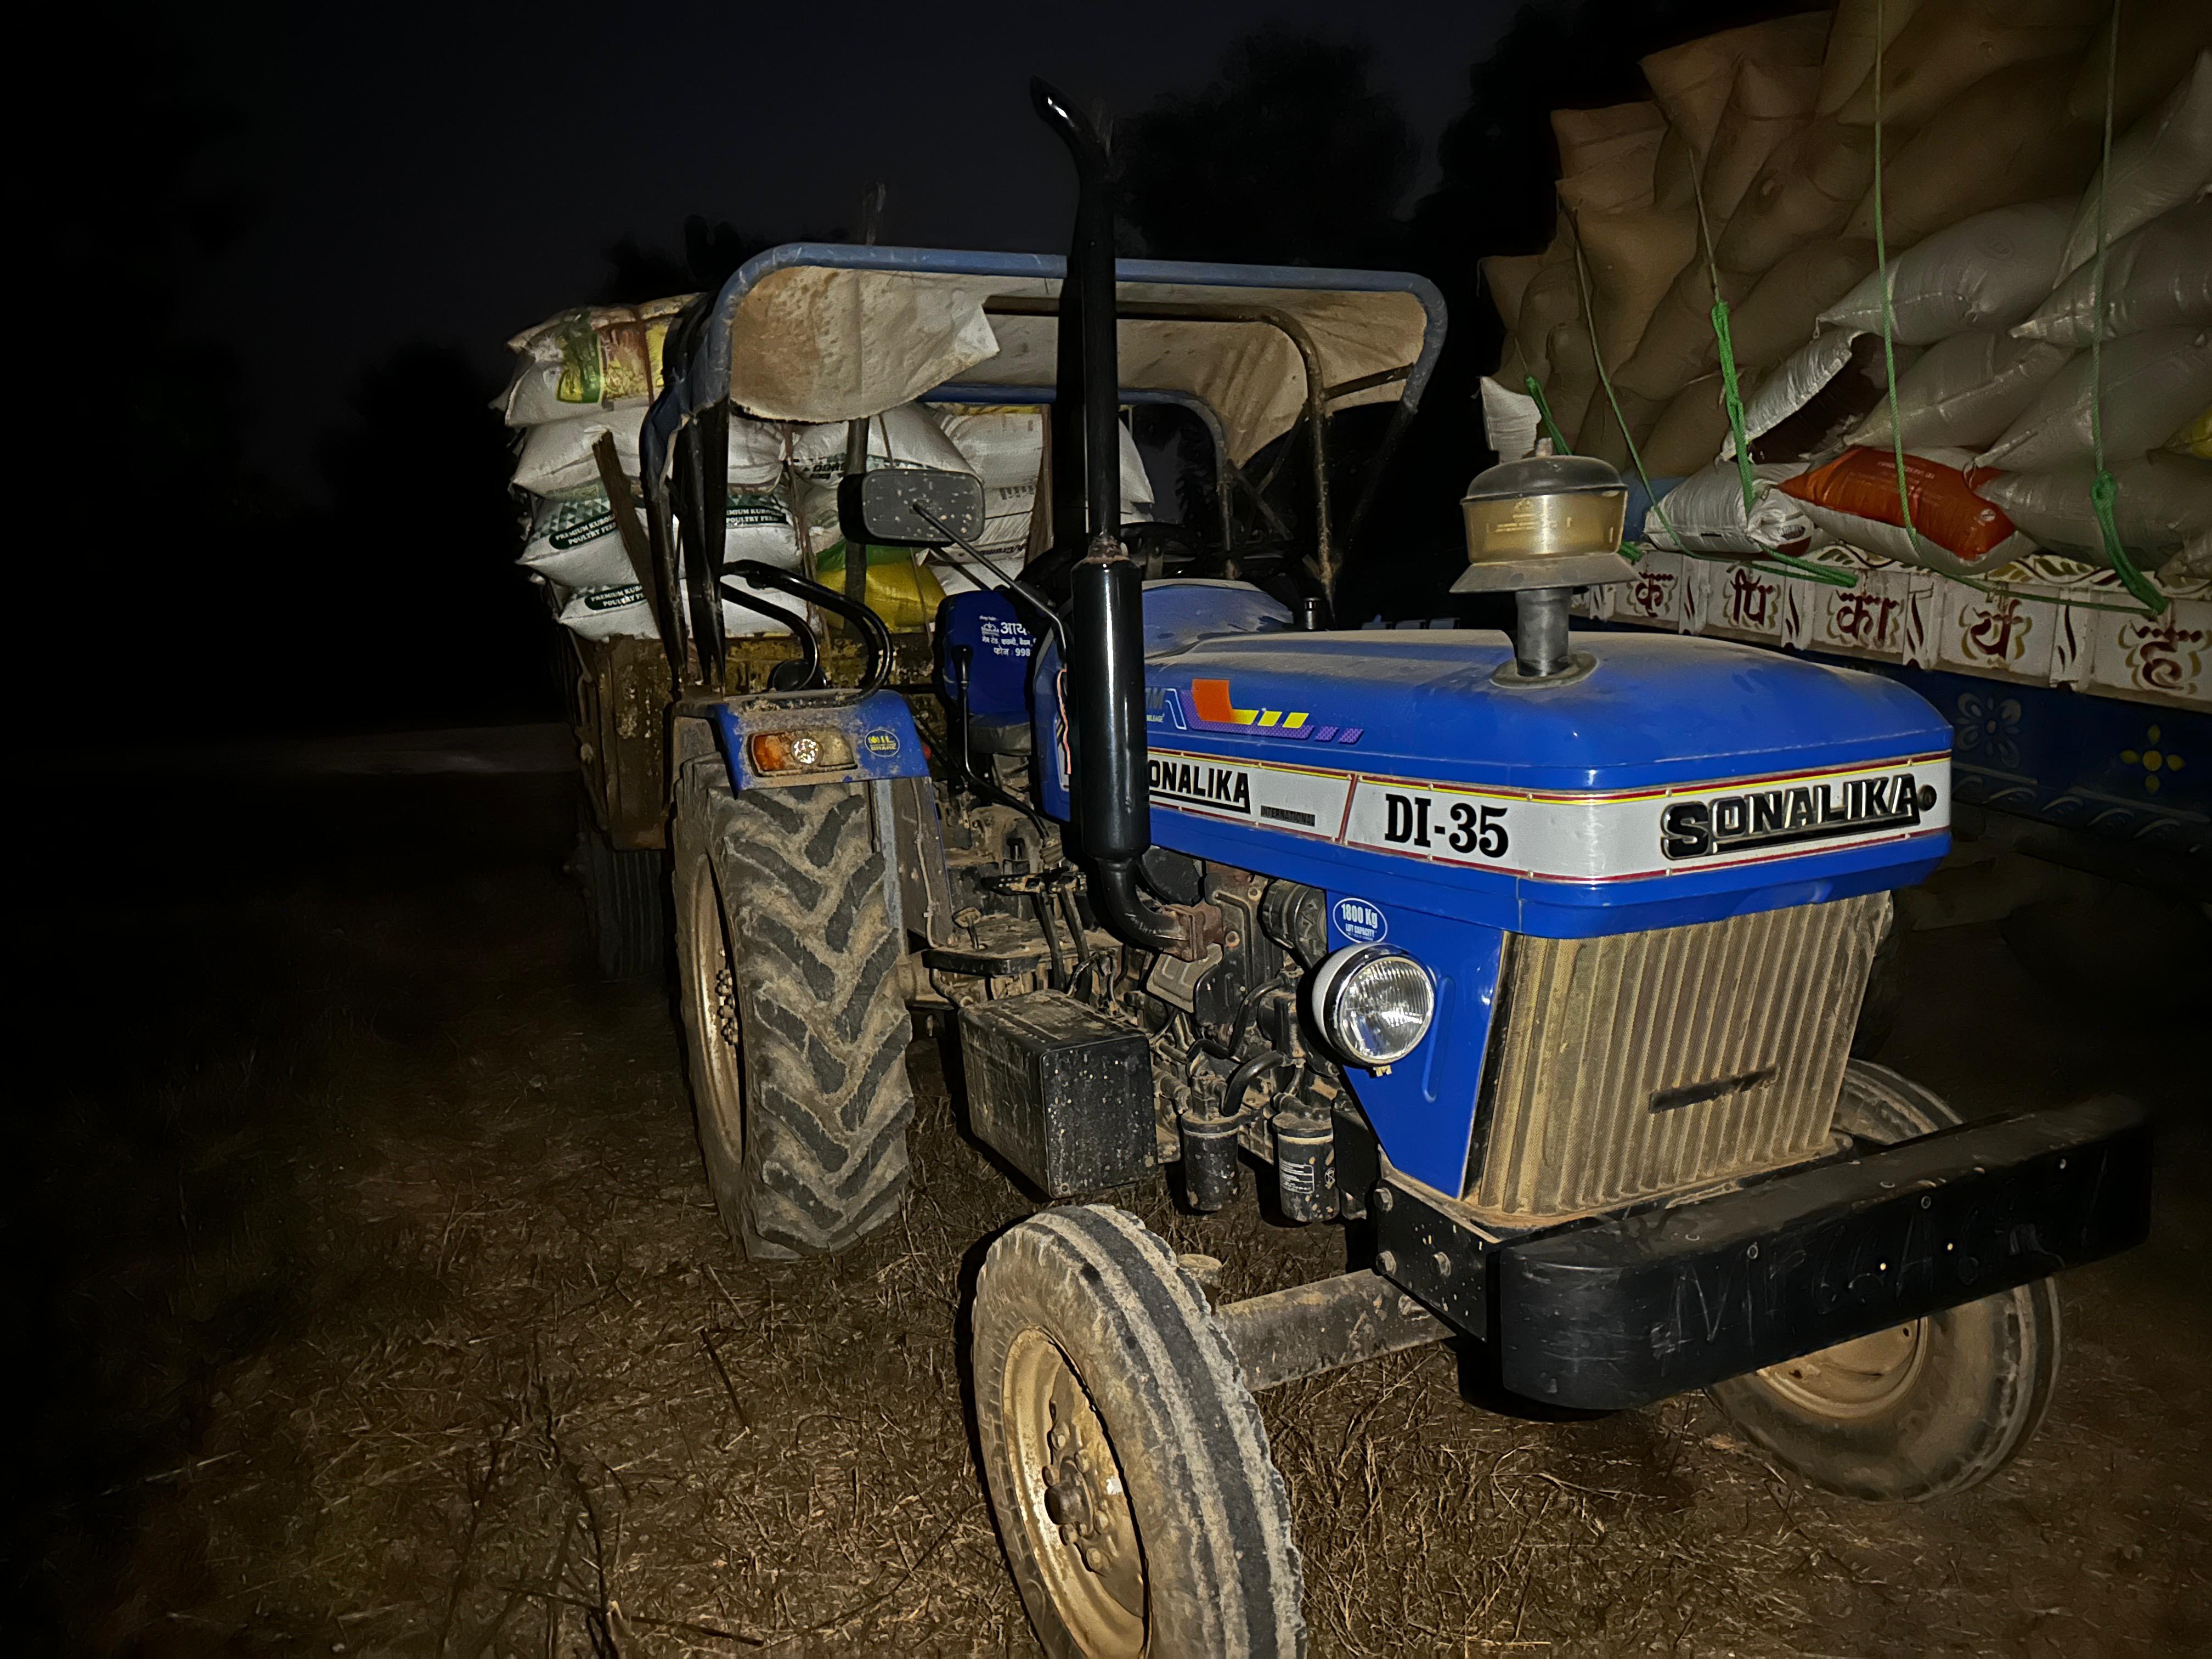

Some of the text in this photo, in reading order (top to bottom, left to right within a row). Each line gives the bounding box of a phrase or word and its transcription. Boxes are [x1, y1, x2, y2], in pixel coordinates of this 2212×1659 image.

[555, 524, 589, 540] PREMIUM
[568, 528, 601, 545] POULTRY
[591, 590, 624, 602] PREMIUM
[1015, 647, 1031, 657] 998
[1149, 760, 1250, 814] ONALIKA
[1261, 806, 1315, 827] INTERNATIONAL
[1385, 793, 1508, 858] DI-35
[1661, 774, 1921, 860] SONALIKA
[1341, 904, 1378, 929] 1800 Kg
